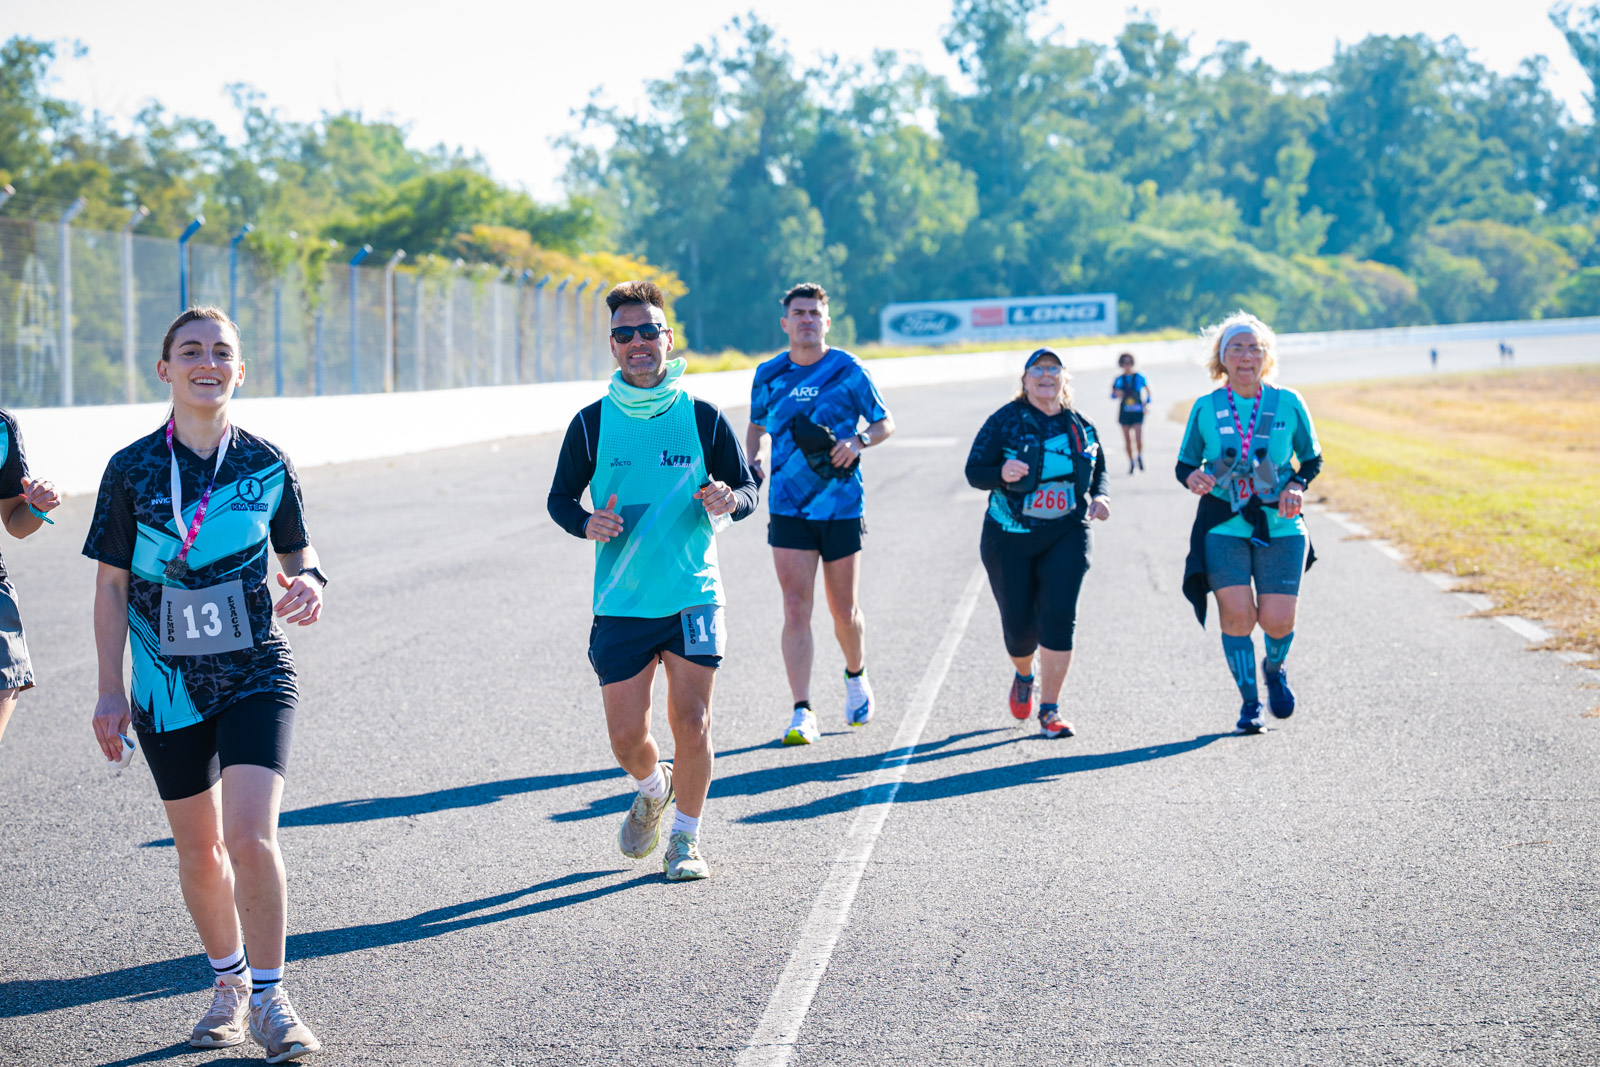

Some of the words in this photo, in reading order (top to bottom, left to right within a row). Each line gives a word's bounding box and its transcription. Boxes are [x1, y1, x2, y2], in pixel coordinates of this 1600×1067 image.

[901, 316, 949, 332] Ford
[1012, 305, 1099, 322] LONG
[788, 386, 820, 397] ARG
[660, 450, 691, 466] km
[1033, 489, 1066, 510] 266
[166, 600, 175, 642] TIEMPO
[182, 602, 223, 639] 13
[227, 595, 242, 638] EXACTO
[685, 613, 697, 645] TIEMPO
